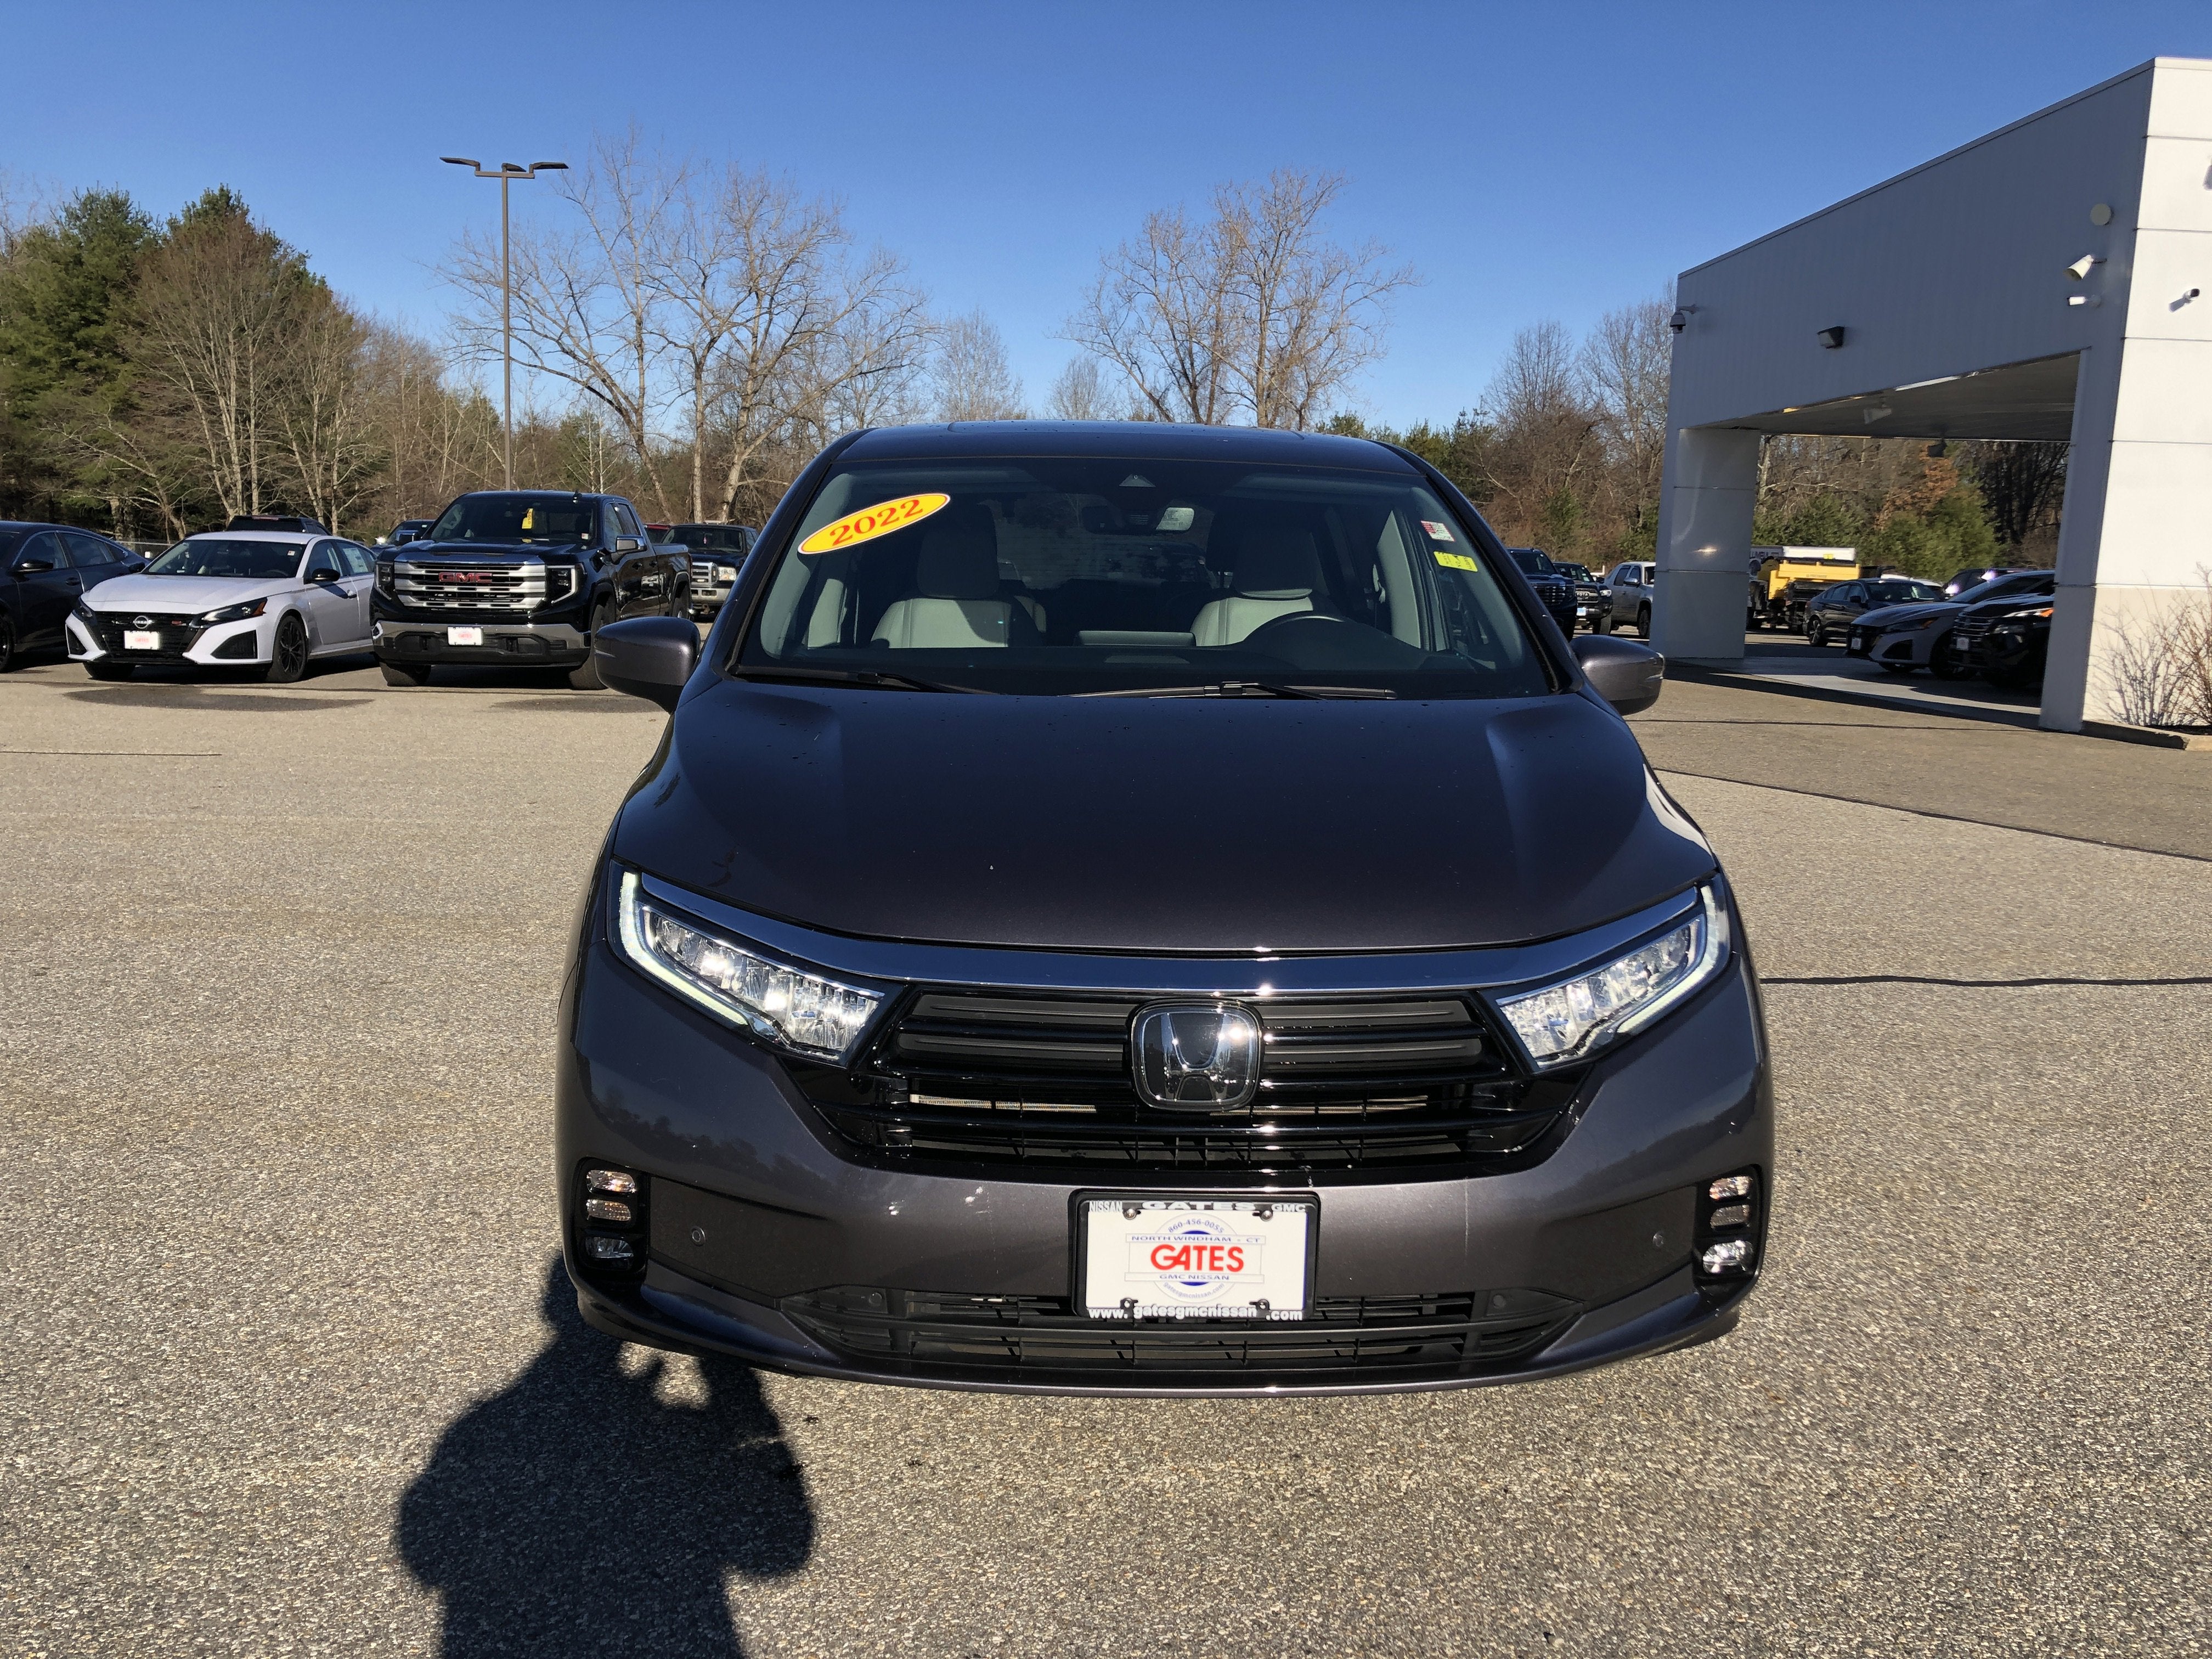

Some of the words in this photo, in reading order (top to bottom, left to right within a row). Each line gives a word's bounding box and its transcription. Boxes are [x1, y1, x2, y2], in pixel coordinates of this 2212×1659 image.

[830, 500, 923, 546] 2022
[439, 572, 493, 583] GMC
[1089, 1201, 1123, 1212] NISSAN
[1142, 1201, 1256, 1211] GATES
[1271, 1204, 1306, 1212] GMC
[1168, 1218, 1224, 1234] 860-456-0055
[1150, 1244, 1244, 1272] GATES
[1163, 1282, 1225, 1299] gatesgmcnissan.com
